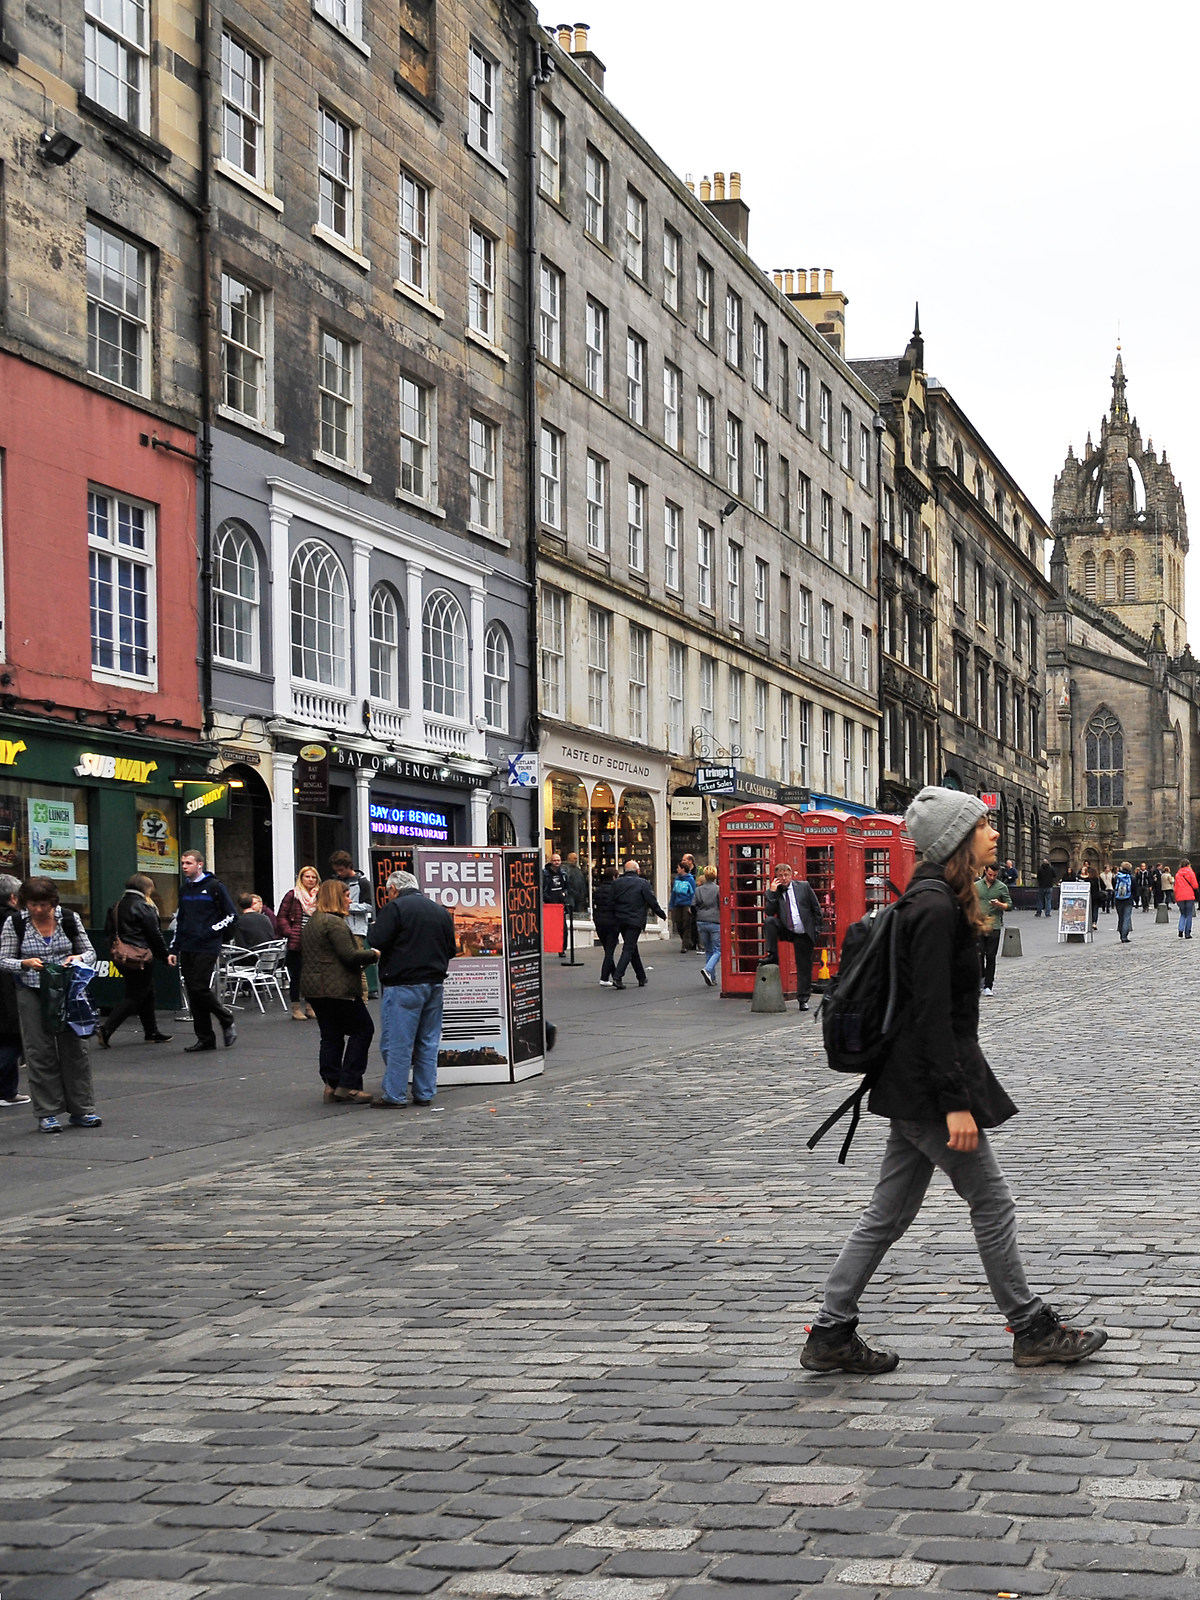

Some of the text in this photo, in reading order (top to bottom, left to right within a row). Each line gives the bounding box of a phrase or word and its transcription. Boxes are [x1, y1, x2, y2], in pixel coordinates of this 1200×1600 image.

[73, 752, 158, 784] SUBWAY
[338, 750, 364, 767] BAY
[371, 756, 394, 772] OF
[397, 762, 447, 783] BENGAL
[468, 777, 483, 787] 1978
[561, 746, 651, 778] TASTE OF SCOTLAND
[705, 768, 729, 779] fringe
[698, 782, 716, 792] Ticket
[716, 780, 733, 789] Sales
[745, 782, 778, 800] CASHMERE
[185, 785, 225, 815] SUBWAY
[33, 803, 48, 823] £3
[49, 808, 70, 822] LUNCH
[370, 804, 448, 828] BAY OF BENGAL
[142, 818, 168, 839] £2
[399, 824, 449, 841] RESTAURANT
[727, 822, 774, 830] TELEPHONE
[424, 862, 495, 882] FREE
[509, 860, 535, 887] FREE
[424, 887, 497, 907] TOUR
[507, 886, 539, 911] GHOST
[509, 911, 539, 940] TOUR
